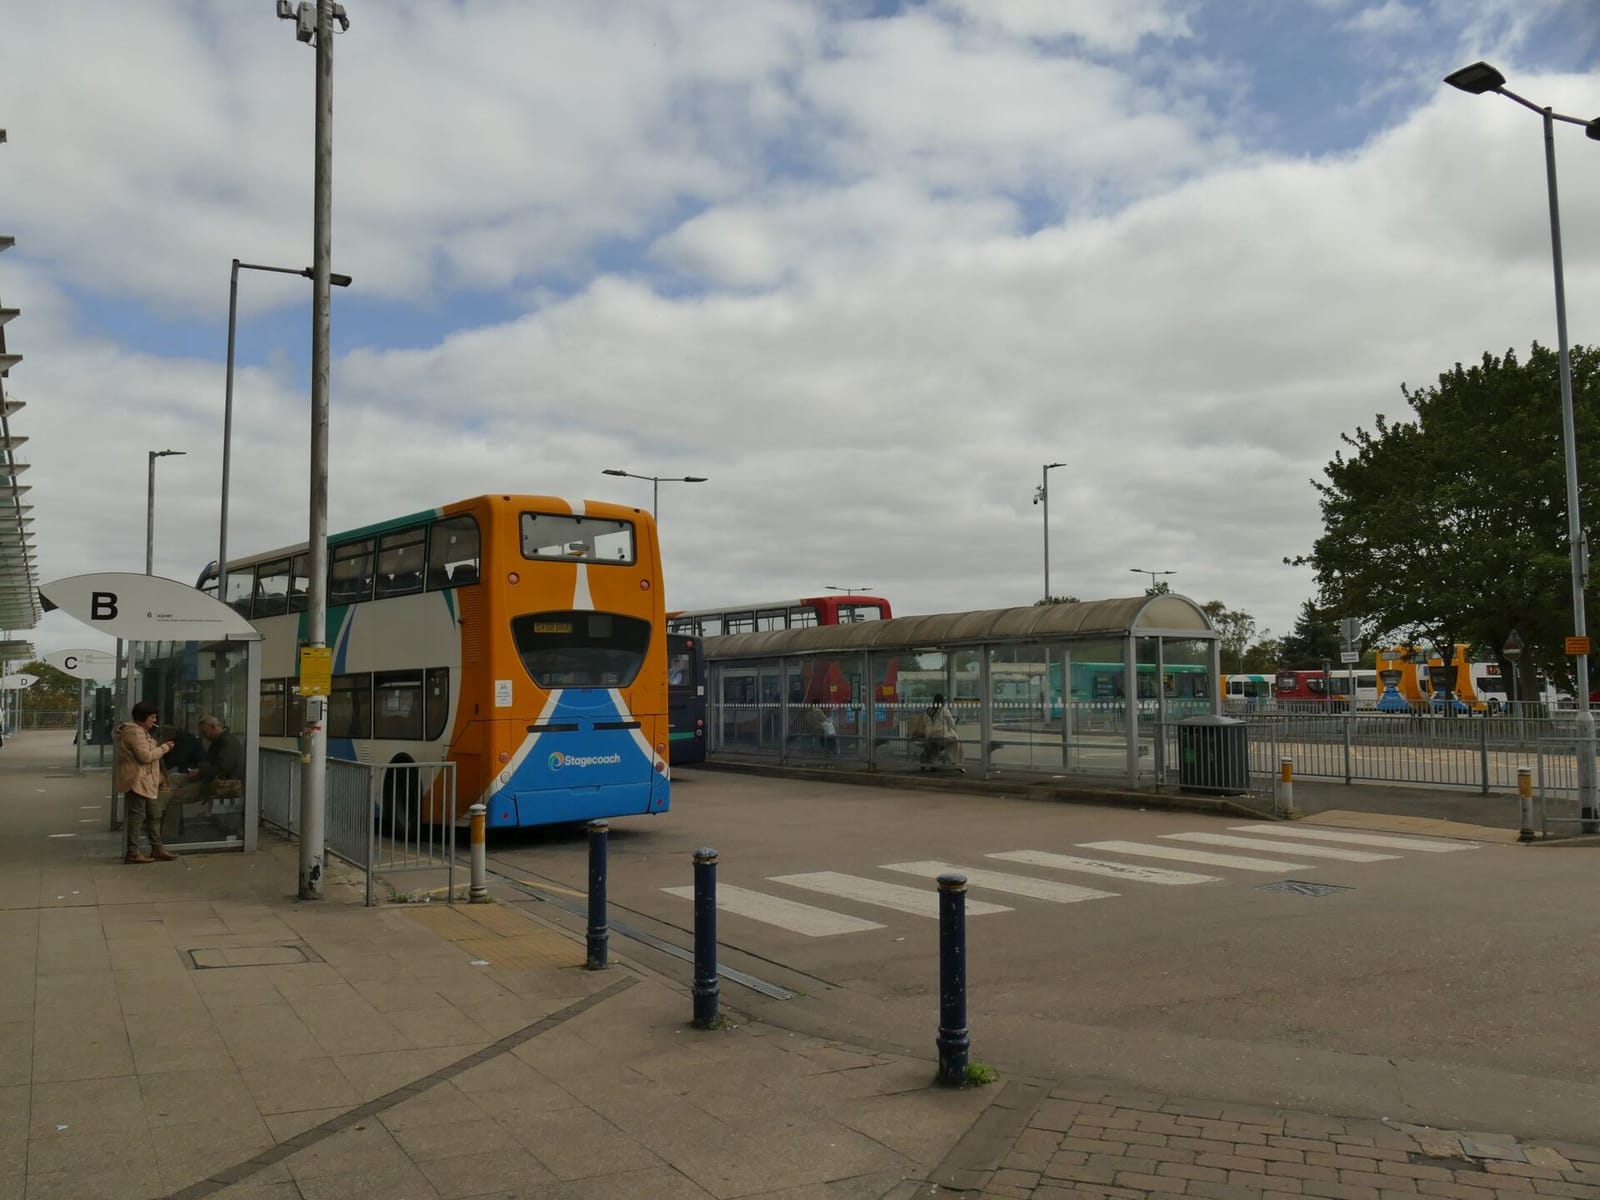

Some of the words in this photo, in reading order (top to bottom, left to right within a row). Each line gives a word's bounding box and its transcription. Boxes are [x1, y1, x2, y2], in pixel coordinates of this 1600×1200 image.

[91, 591, 118, 620] B
[64, 656, 78, 669] C
[20, 678, 28, 686] D
[565, 753, 620, 767] Stagecoach
